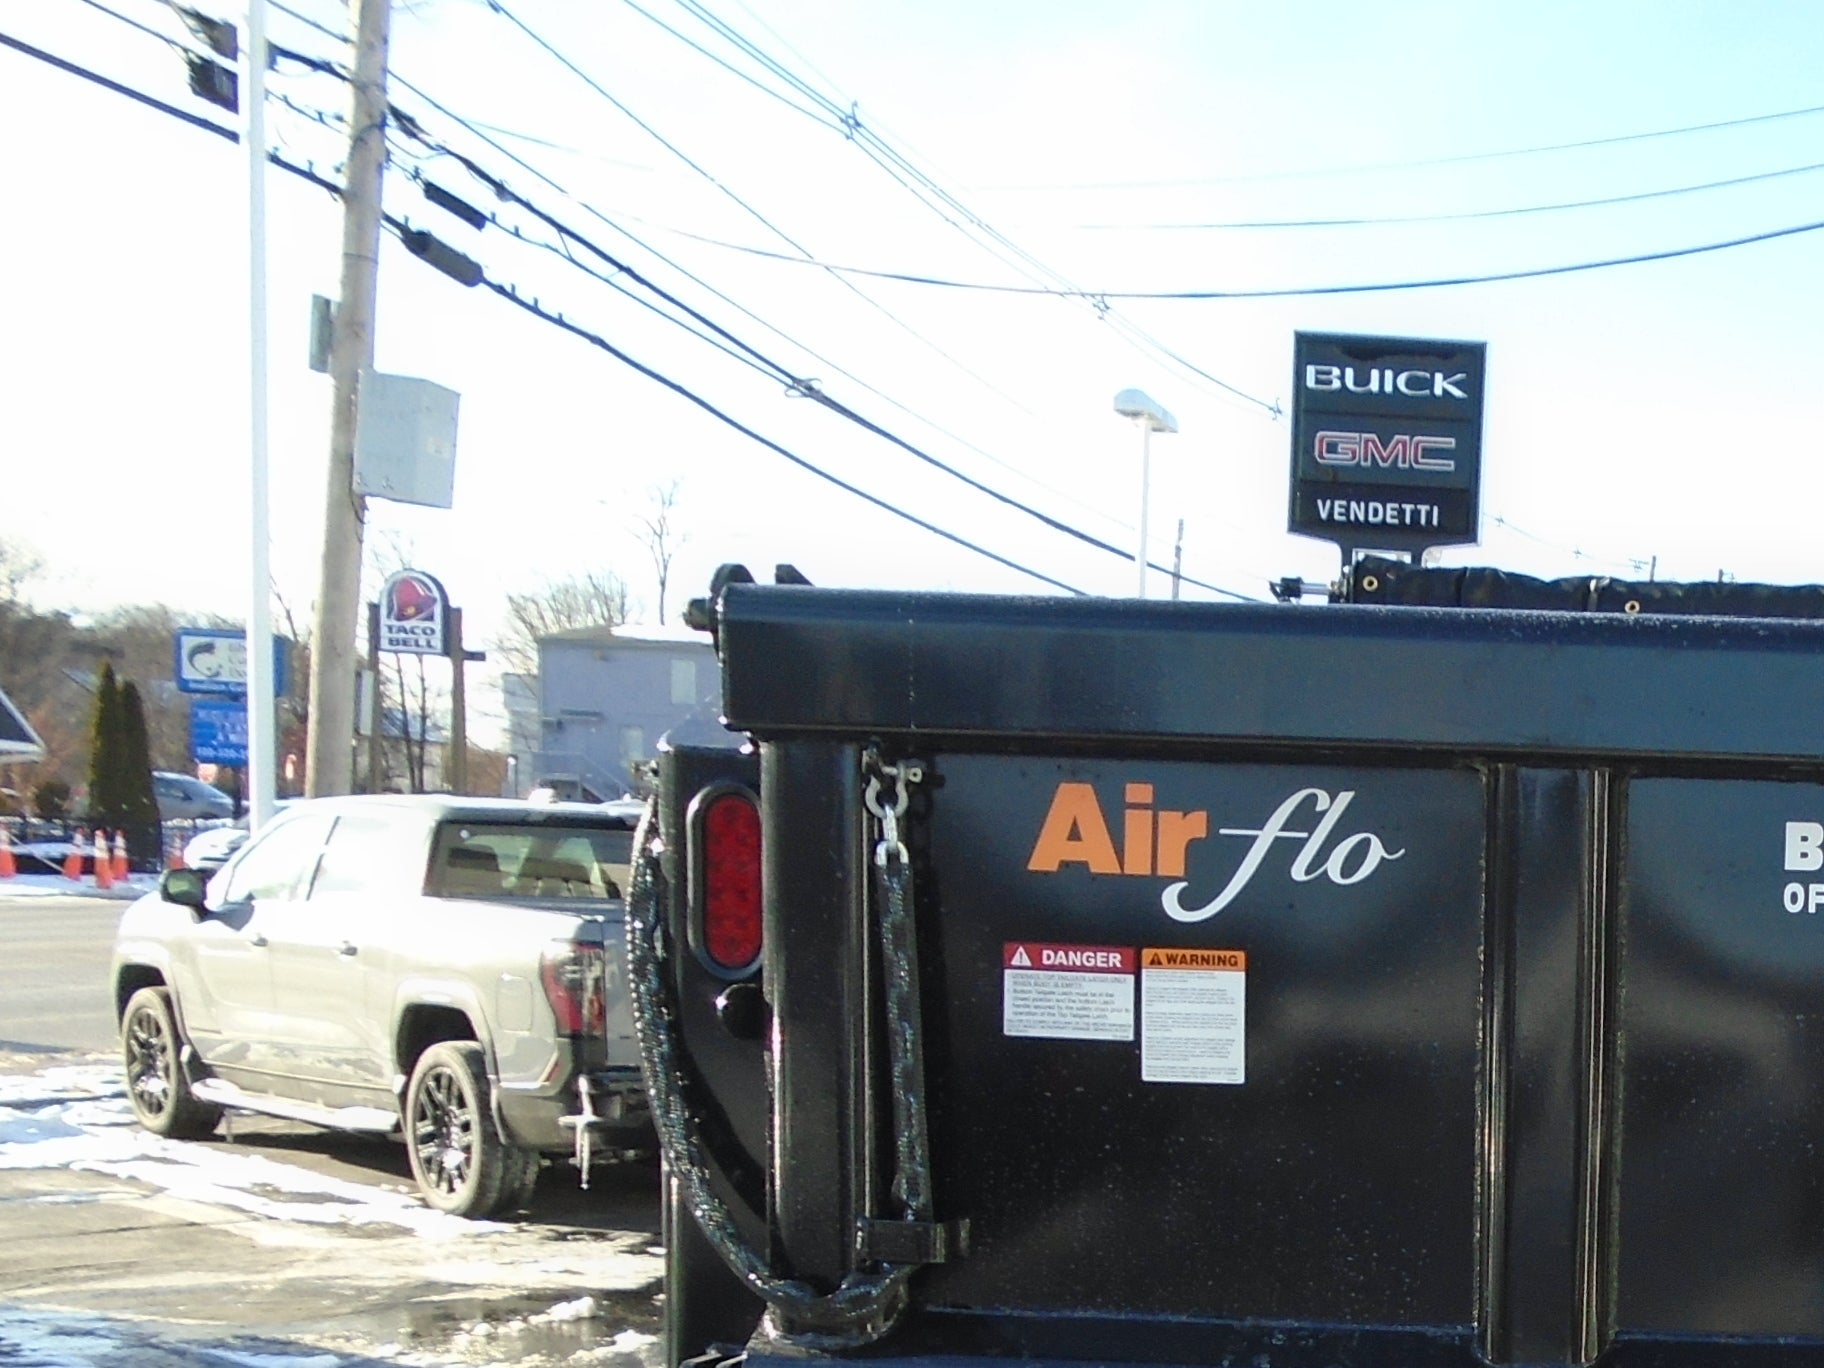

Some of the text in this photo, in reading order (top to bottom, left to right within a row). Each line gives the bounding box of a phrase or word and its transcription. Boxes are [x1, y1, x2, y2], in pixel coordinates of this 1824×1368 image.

[1306, 364, 1468, 399] BUICK
[1314, 430, 1456, 472] GMC
[1316, 498, 1440, 528] VENDETTI
[384, 624, 436, 636] TACO
[388, 637, 436, 649] BELL
[1041, 949, 1122, 968] DANGER
[1165, 952, 1238, 967] WARNING
